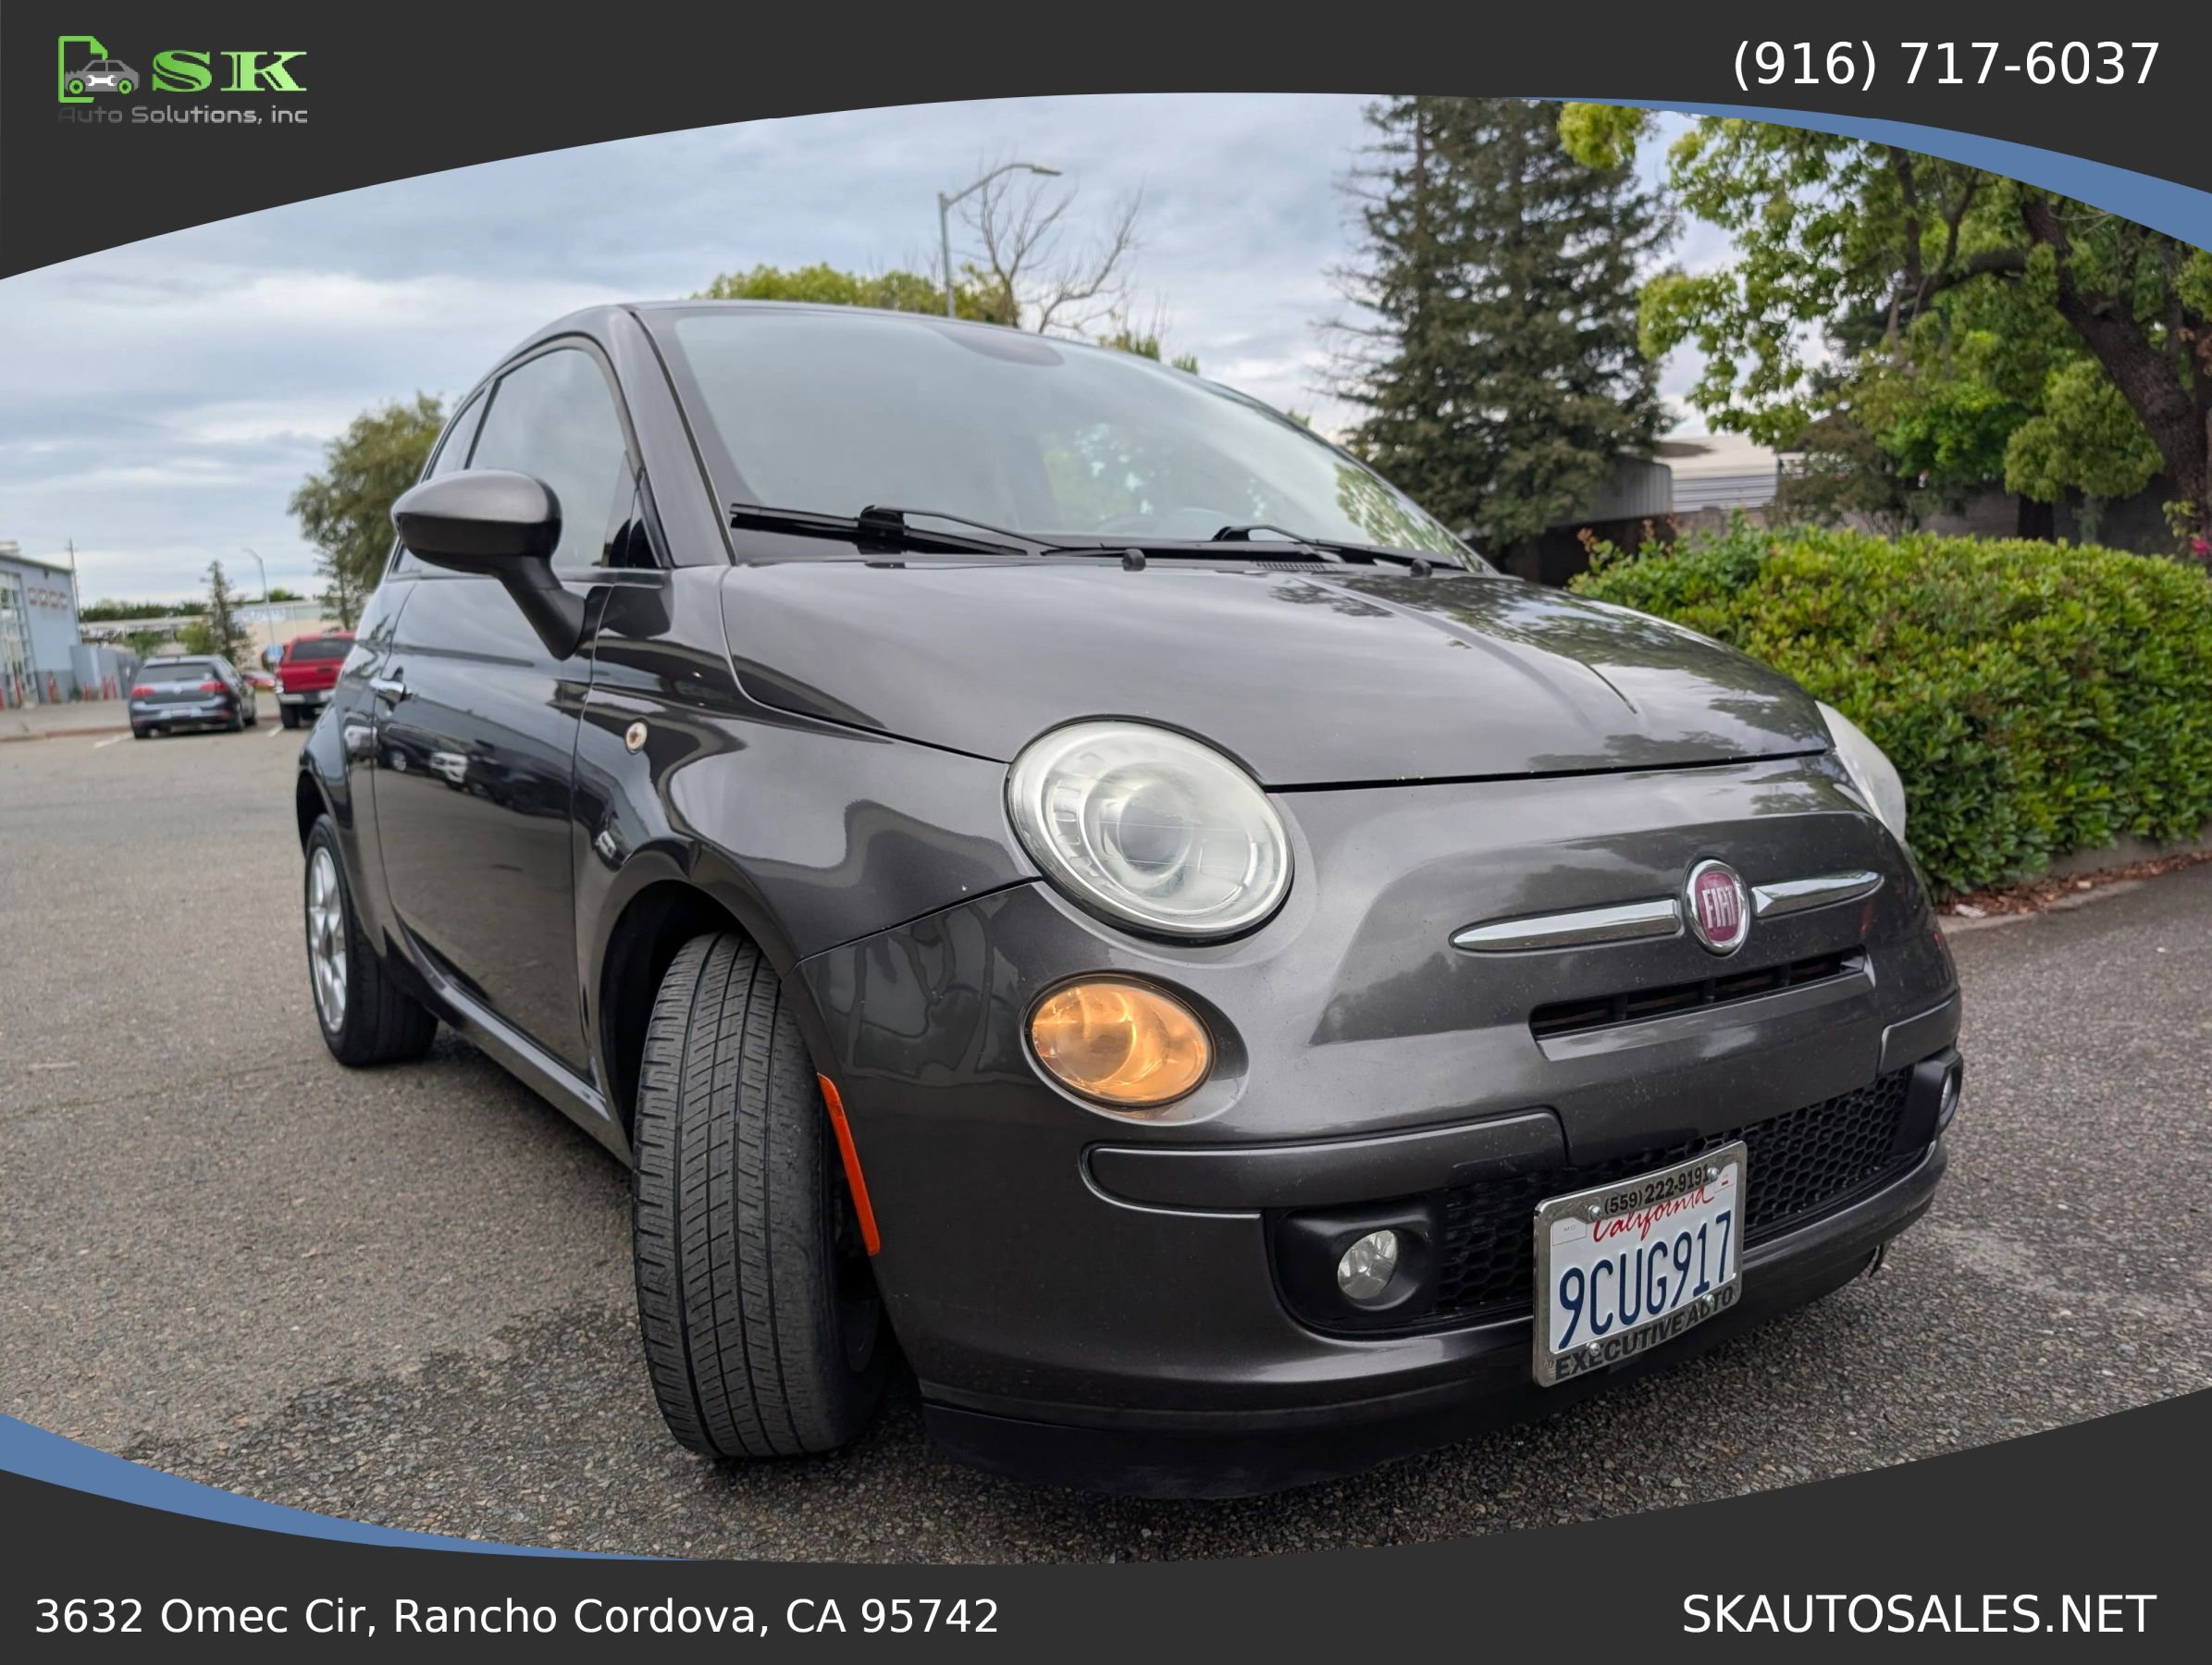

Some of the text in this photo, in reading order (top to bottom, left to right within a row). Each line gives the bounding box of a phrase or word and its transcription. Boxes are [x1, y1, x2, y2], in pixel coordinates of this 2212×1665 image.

[1702, 885, 1738, 929] FIAT
[1604, 1163, 1711, 1215] (559) 222-9191
[1558, 1210, 1732, 1350] 9CUG917
[1555, 1314, 1685, 1380] EXECUTIVE
